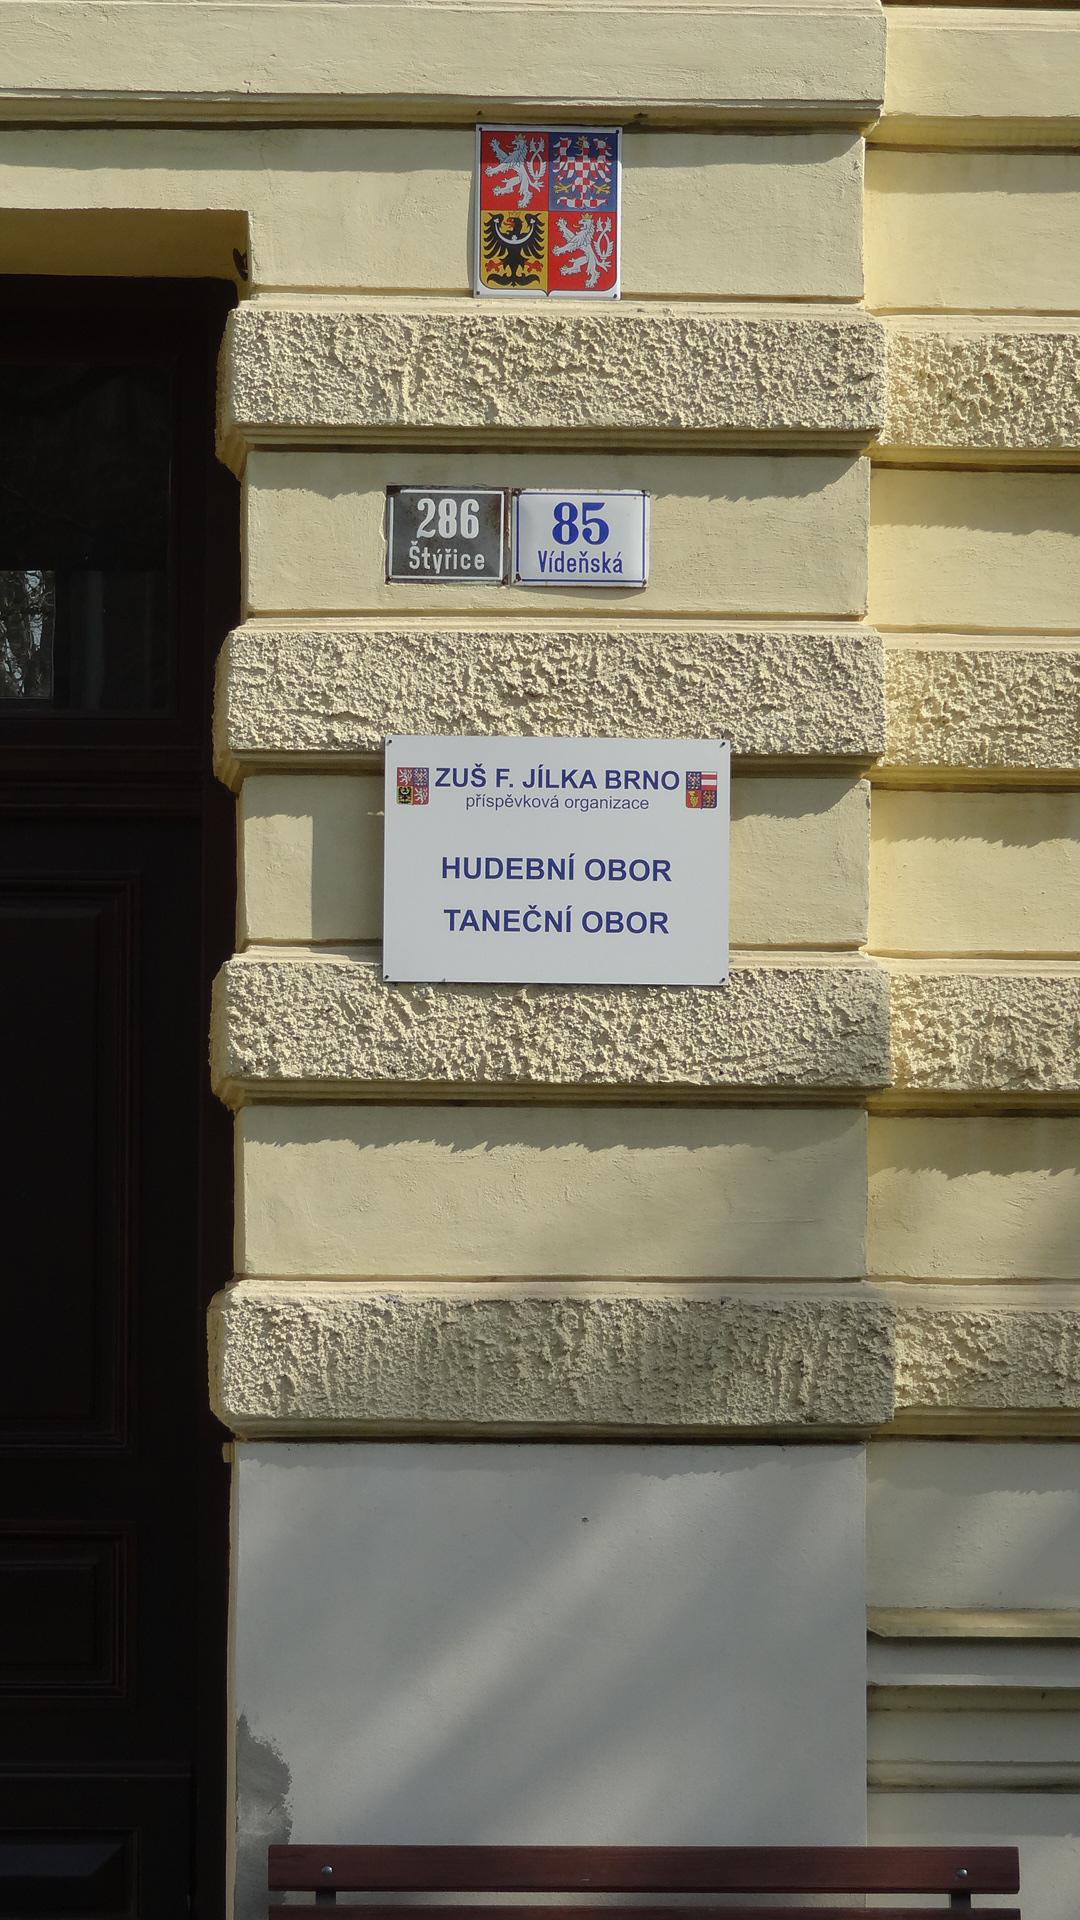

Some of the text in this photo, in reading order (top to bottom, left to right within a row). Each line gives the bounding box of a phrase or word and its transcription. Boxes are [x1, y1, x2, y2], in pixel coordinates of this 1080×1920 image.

[416, 498, 480, 539] 286
[552, 502, 610, 545] 85
[408, 540, 485, 574] Štýřice
[537, 550, 623, 574] Vídeňská
[434, 763, 680, 791] ZUŠ F. JÍLKA BRNO
[465, 793, 650, 812] příspěvková organizace
[442, 853, 672, 882] HUDEBNÍ OBOR
[443, 904, 669, 934] TANEČNÍ OBOR
